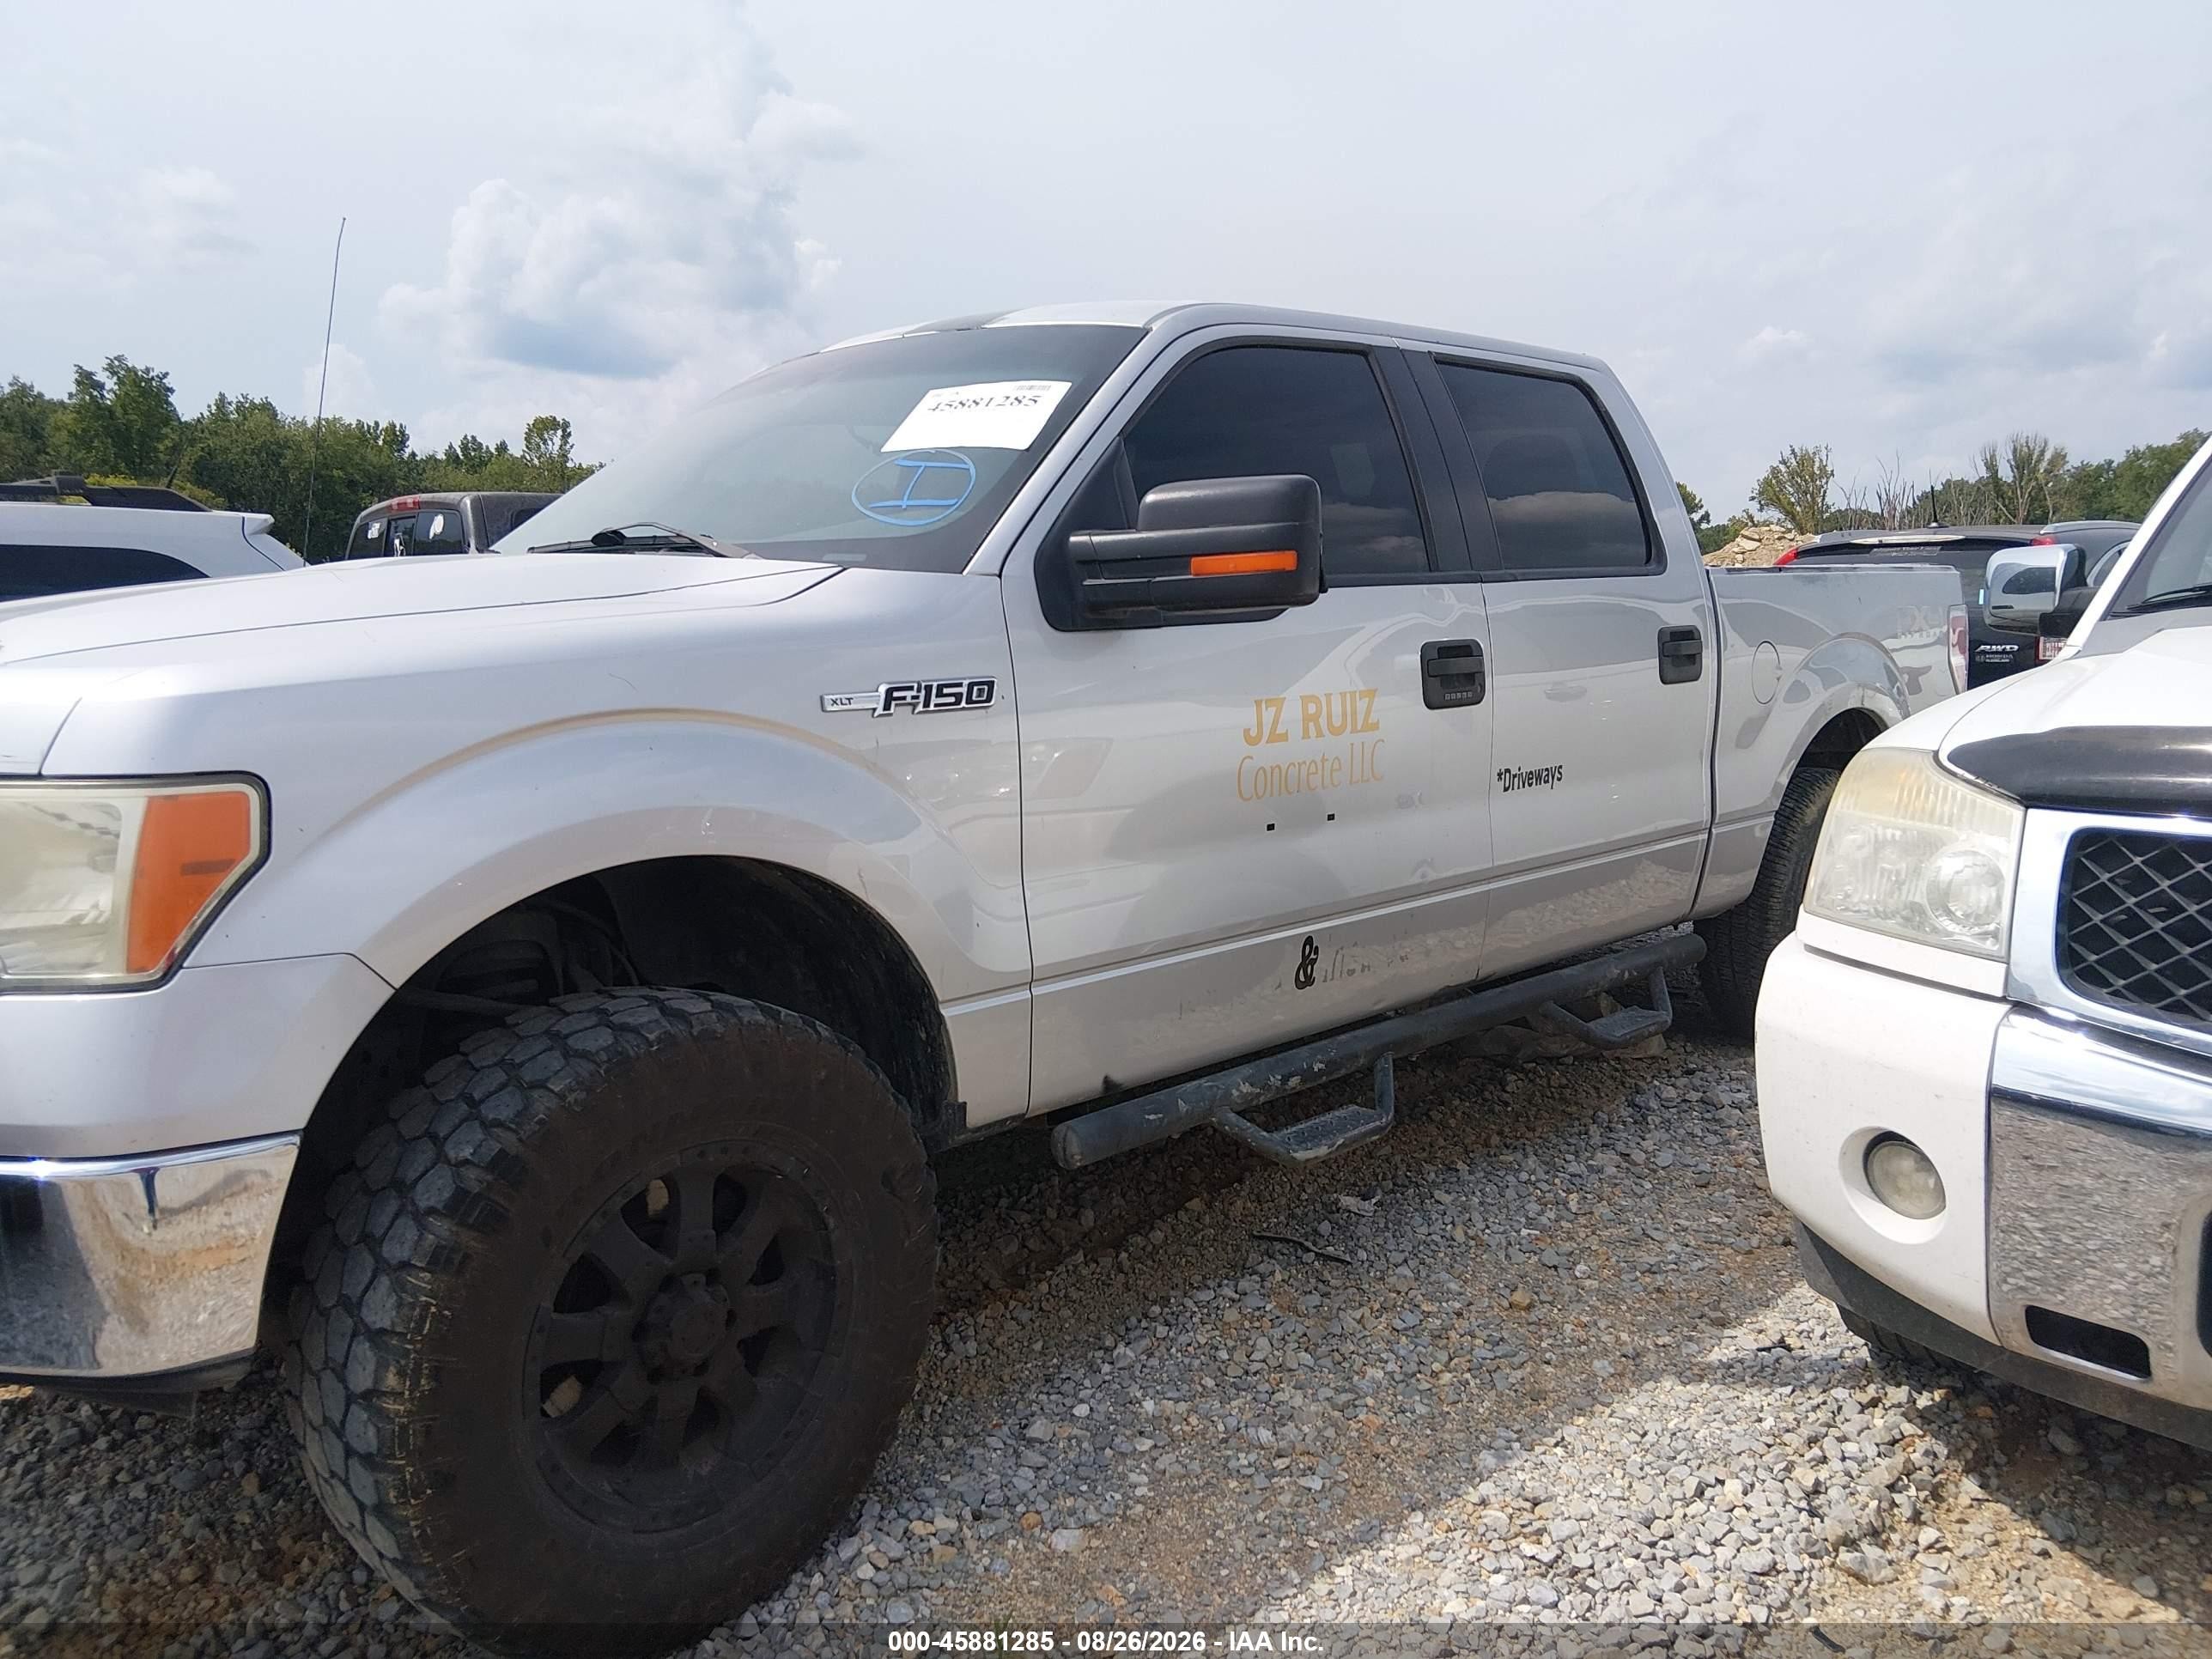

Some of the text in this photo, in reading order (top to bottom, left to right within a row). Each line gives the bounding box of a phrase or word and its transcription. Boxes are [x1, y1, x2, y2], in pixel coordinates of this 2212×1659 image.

[927, 395, 1042, 411] 45881285
[830, 677, 997, 715] XLT F-150
[1243, 688, 1381, 747] JZ RUIZ
[1237, 738, 1385, 802] Concrete LLC
[1294, 935, 1320, 990] &
